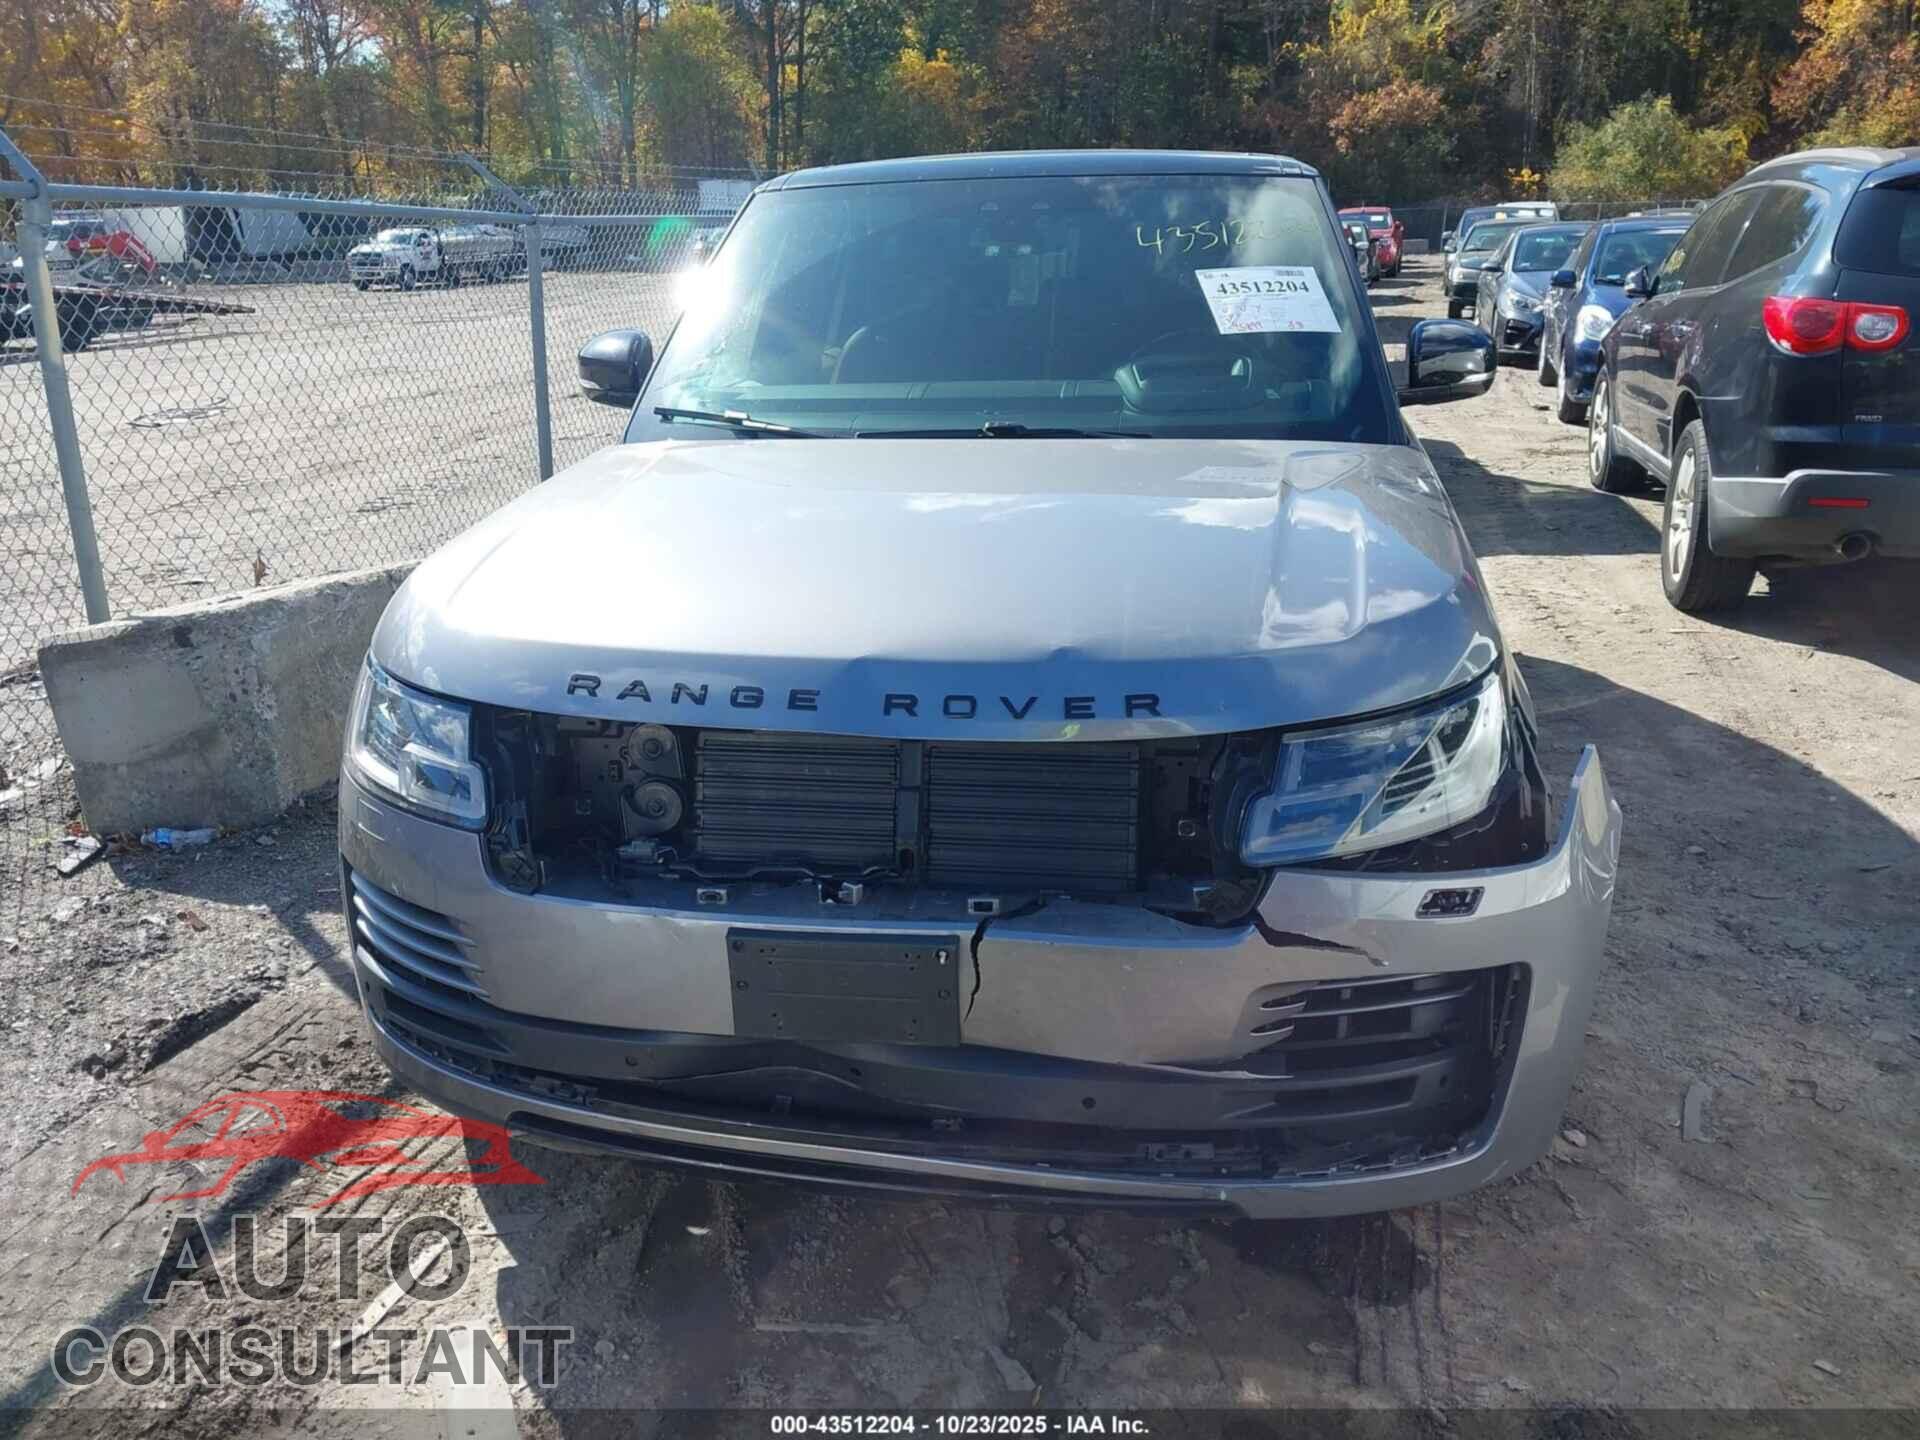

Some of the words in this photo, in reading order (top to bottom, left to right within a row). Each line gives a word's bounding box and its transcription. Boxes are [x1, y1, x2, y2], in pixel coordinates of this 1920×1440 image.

[1216, 279, 1310, 295] 43512204
[566, 673, 820, 712] RANGE
[883, 692, 1162, 720] ROVER
